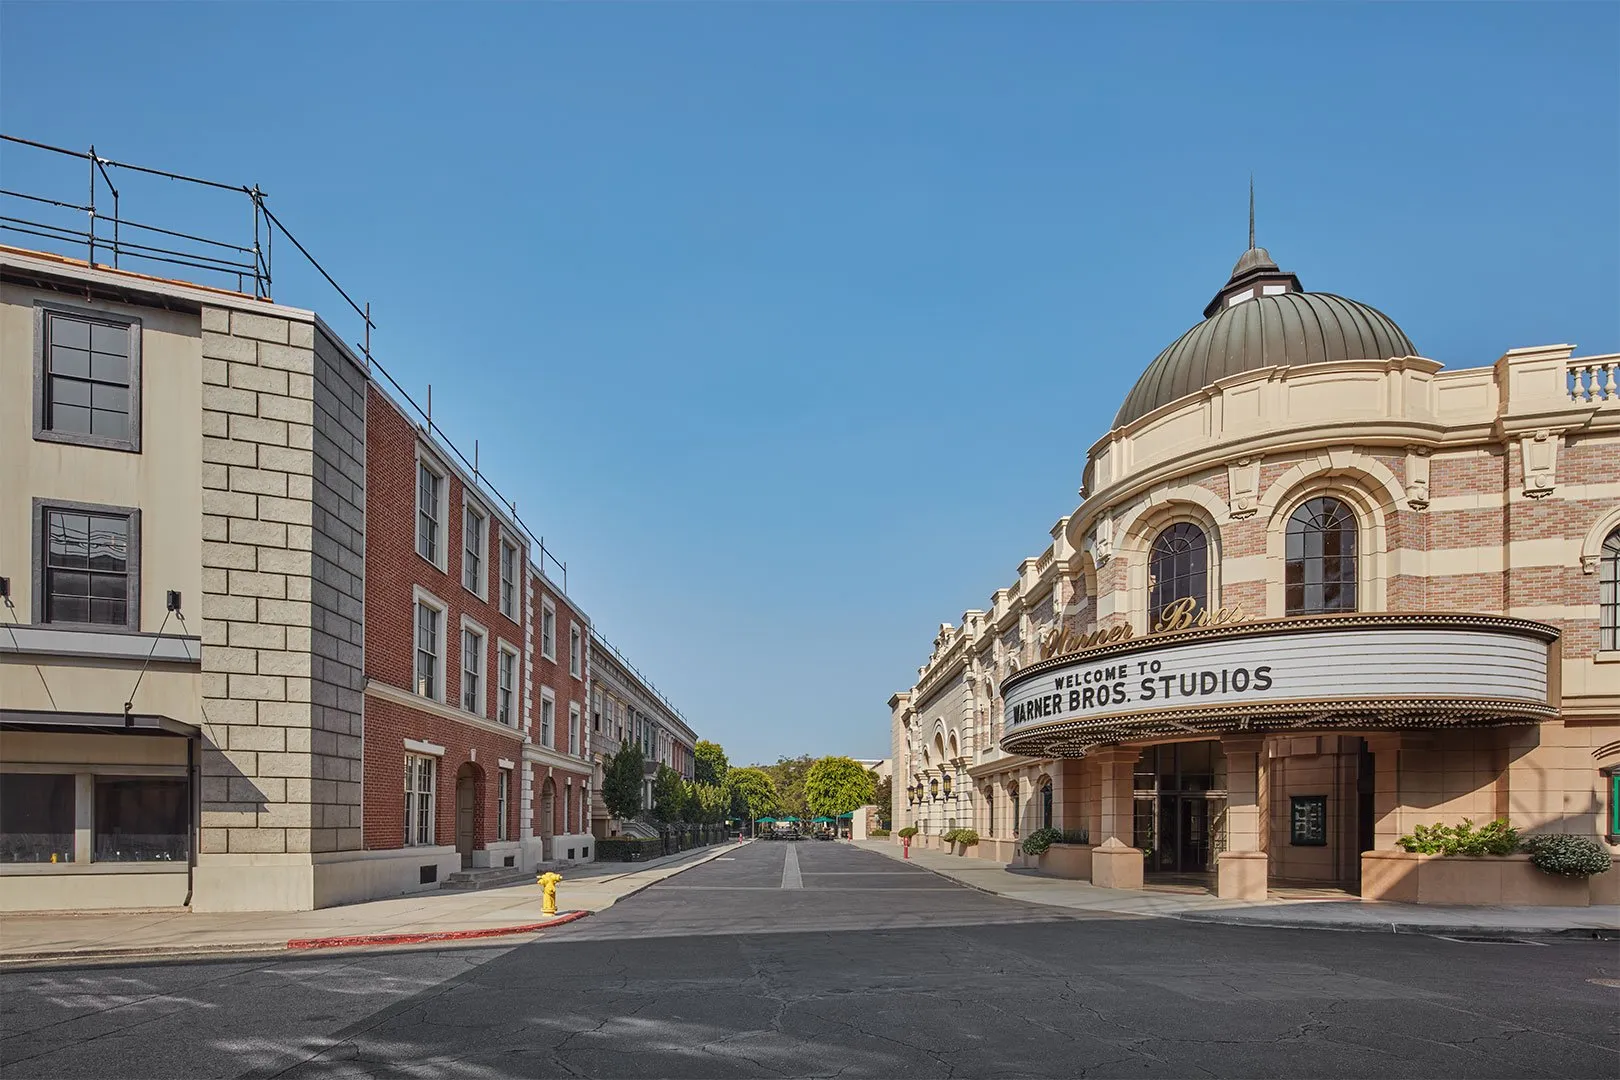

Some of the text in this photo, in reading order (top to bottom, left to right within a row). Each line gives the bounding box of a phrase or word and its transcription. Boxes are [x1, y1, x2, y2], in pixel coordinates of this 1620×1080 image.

[1041, 596, 1255, 660] Warner Bros.
[1013, 666, 1273, 725] WARNER BROS. STUDIOS
[1055, 660, 1162, 690] WELCOME TO
